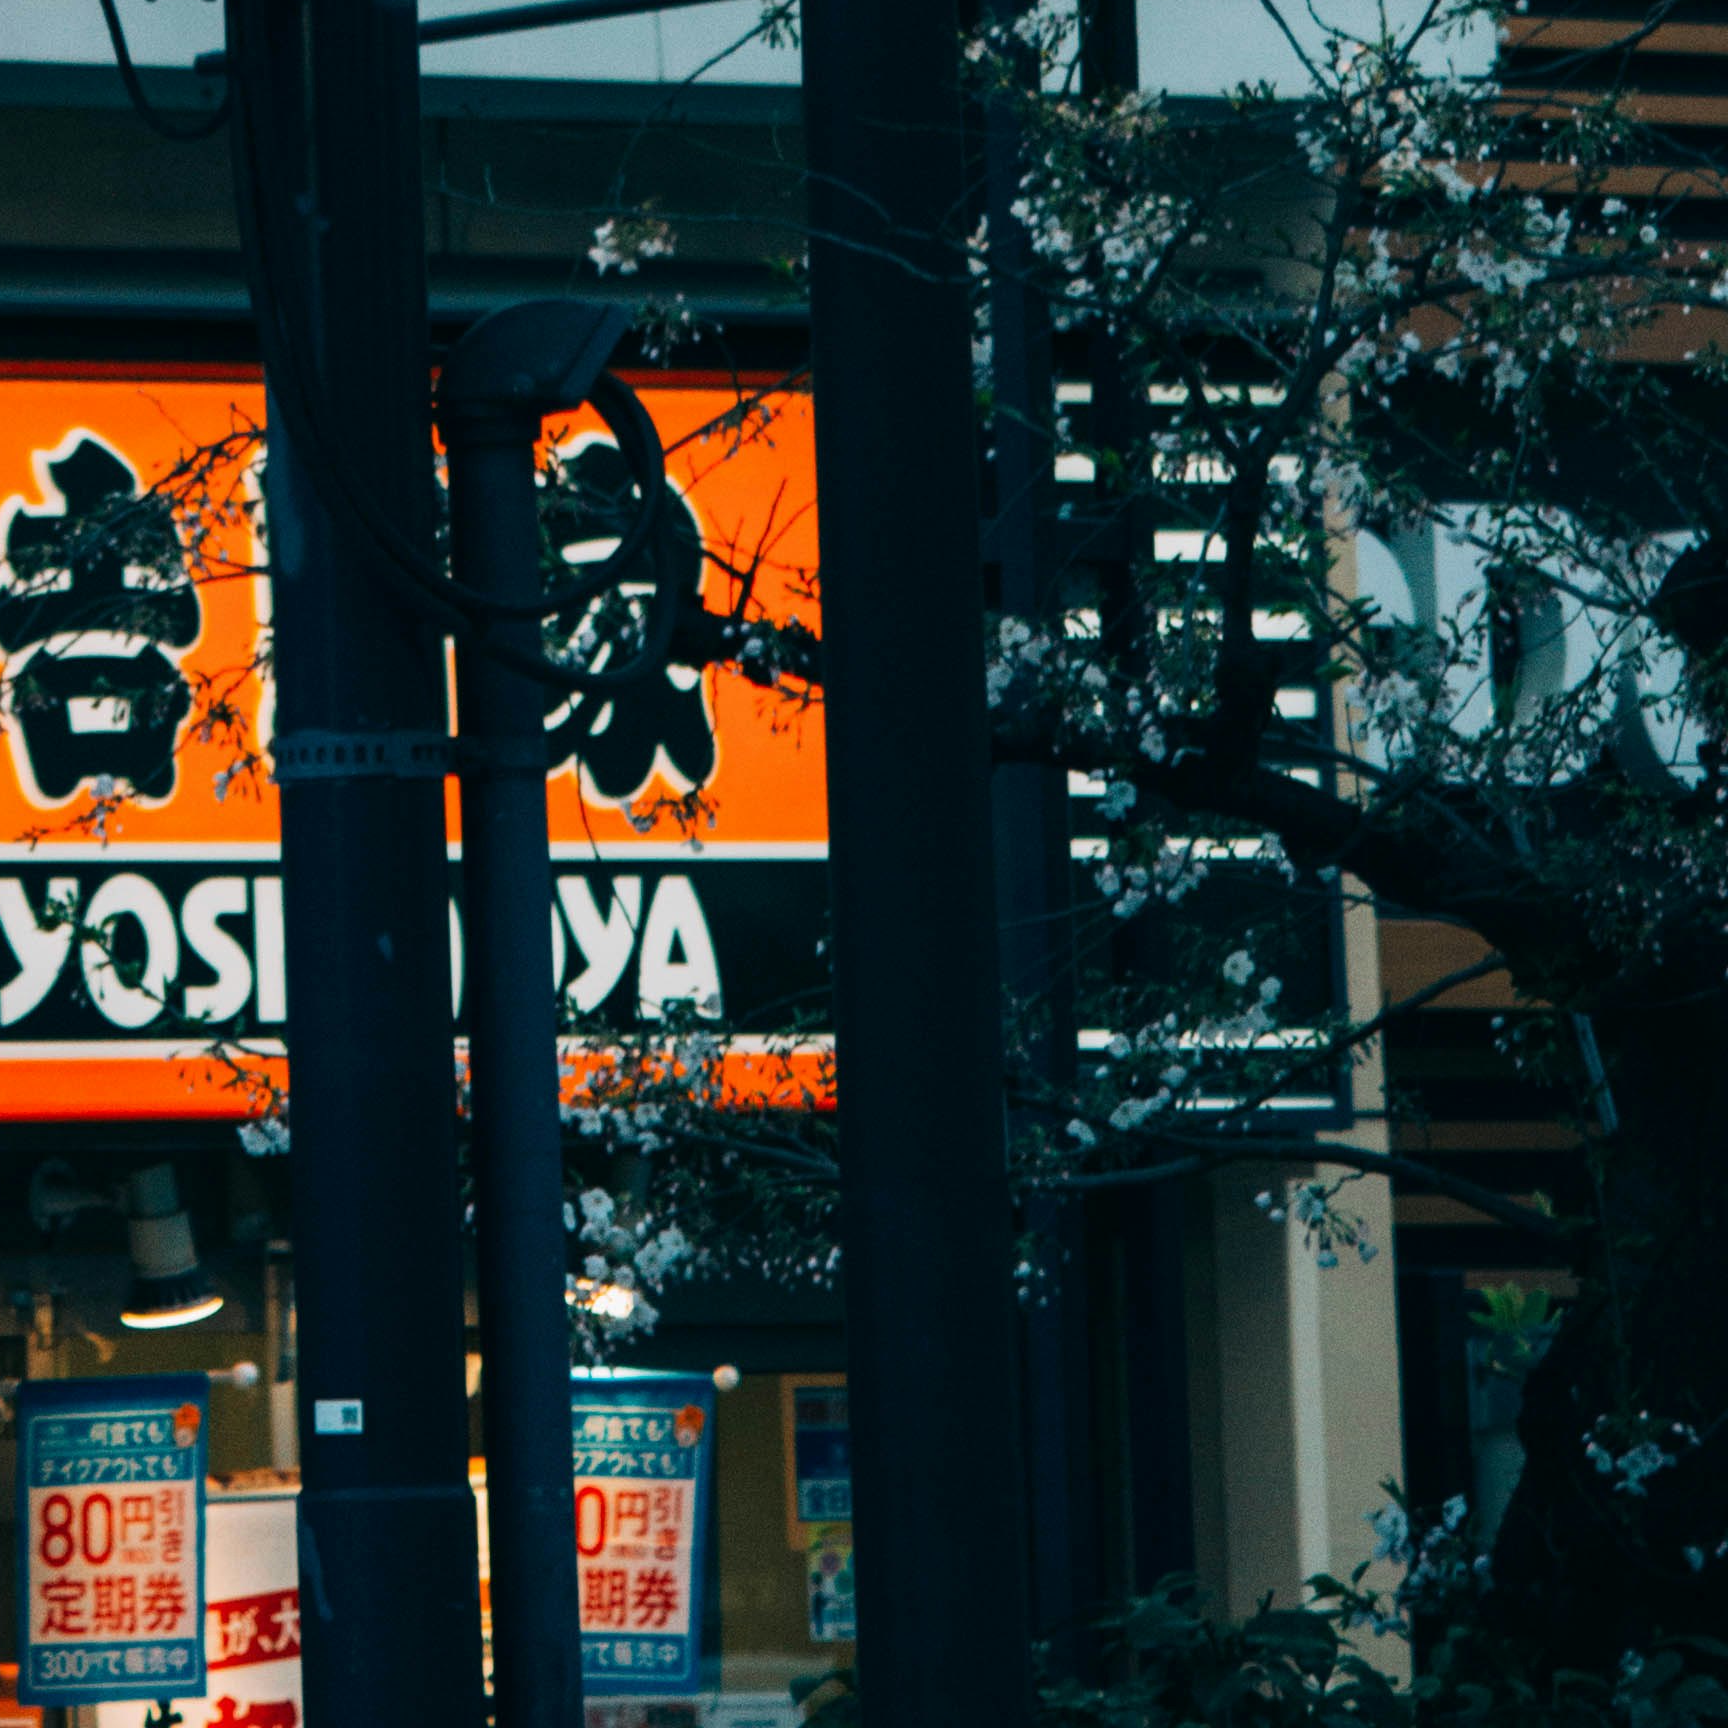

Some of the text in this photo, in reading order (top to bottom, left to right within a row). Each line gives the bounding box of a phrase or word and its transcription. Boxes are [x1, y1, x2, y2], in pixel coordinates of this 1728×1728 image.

[40, 1492, 155, 1568] 80円
[575, 1485, 649, 1557] 0円
[39, 1573, 188, 1637] 定期券
[583, 1568, 679, 1628] 期券
